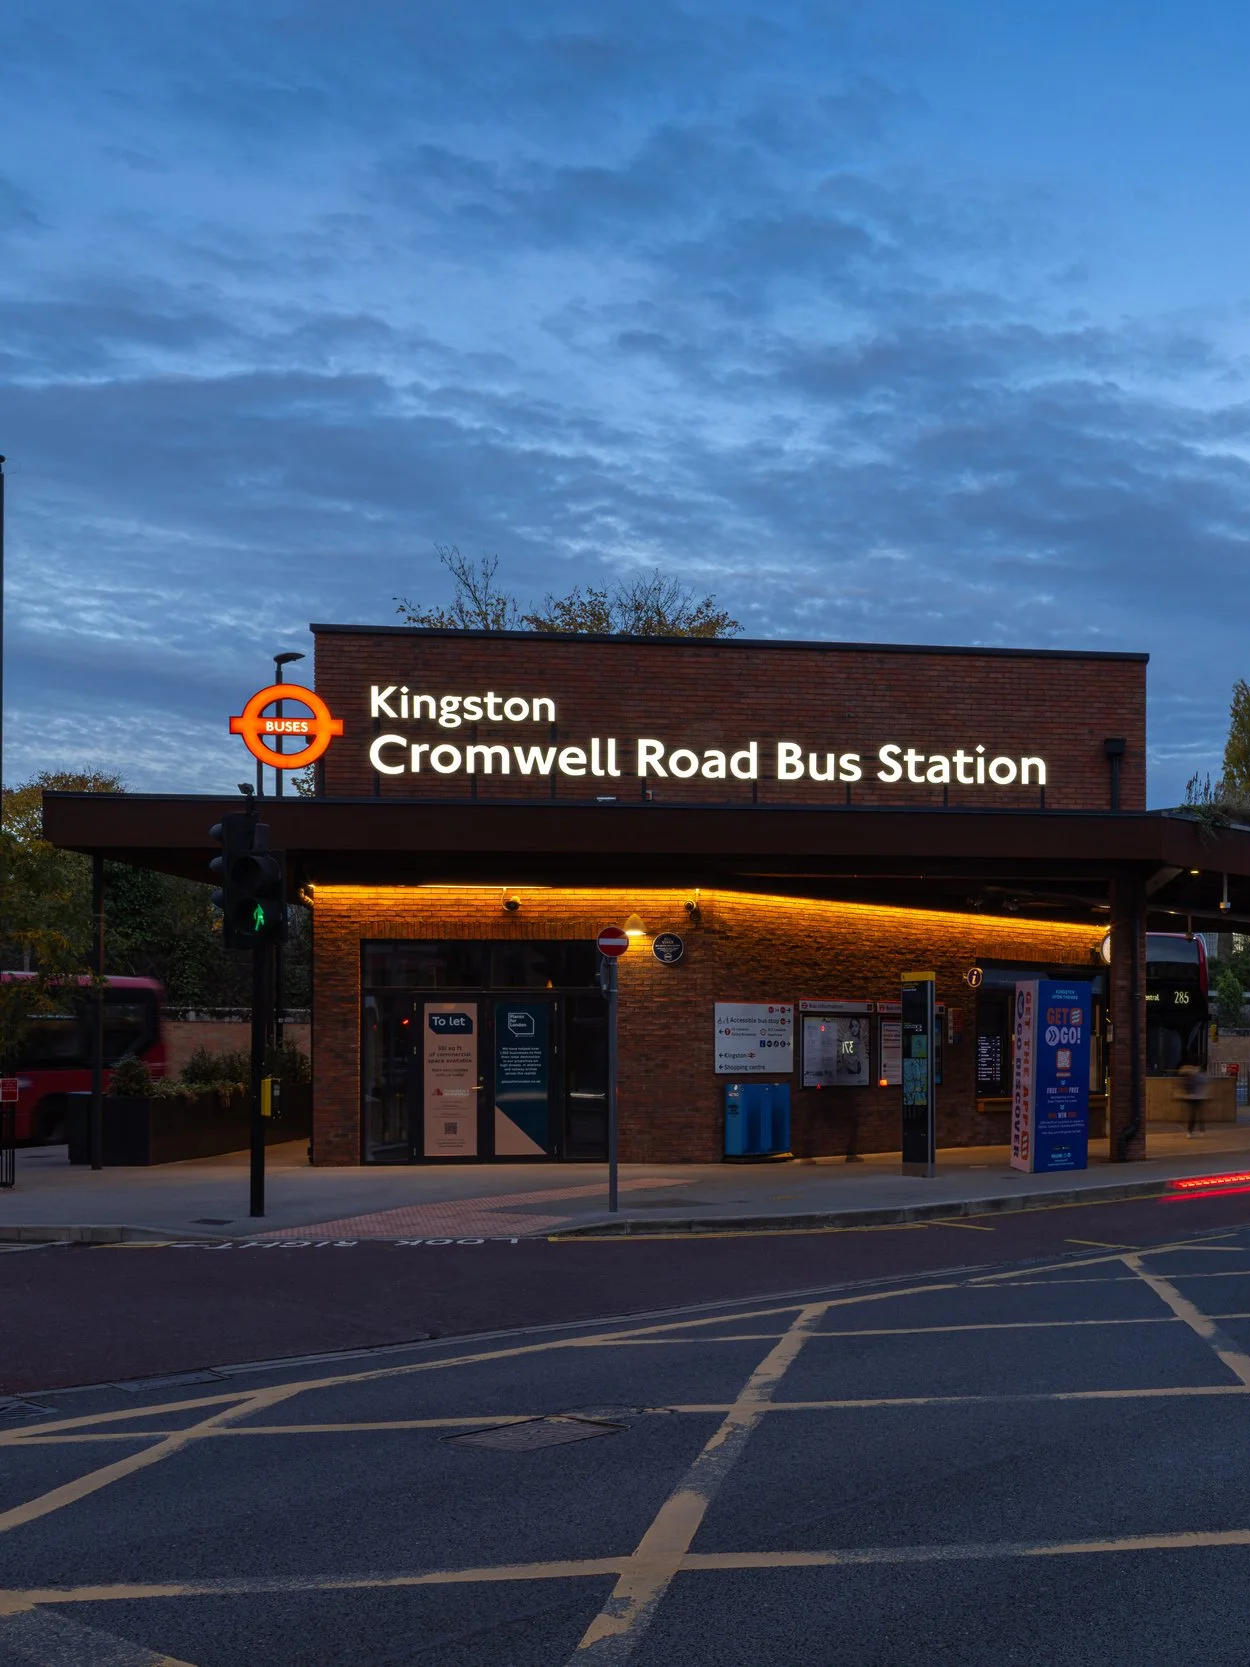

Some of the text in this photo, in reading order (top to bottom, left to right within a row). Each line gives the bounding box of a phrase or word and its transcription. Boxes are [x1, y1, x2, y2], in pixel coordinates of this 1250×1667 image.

[370, 685, 556, 728] Kingston
[266, 721, 309, 733] BUSES
[369, 734, 1047, 786] Cromwell Road Bus Station
[1174, 990, 1190, 1004] 285
[432, 1016, 466, 1026] To let
[730, 1016, 757, 1024] Accessible
[758, 1016, 768, 1024] bus
[1046, 1008, 1069, 1025] GET
[1060, 1026, 1081, 1044] GO!
[204, 1238, 520, 1249] LOOK RIGHT
